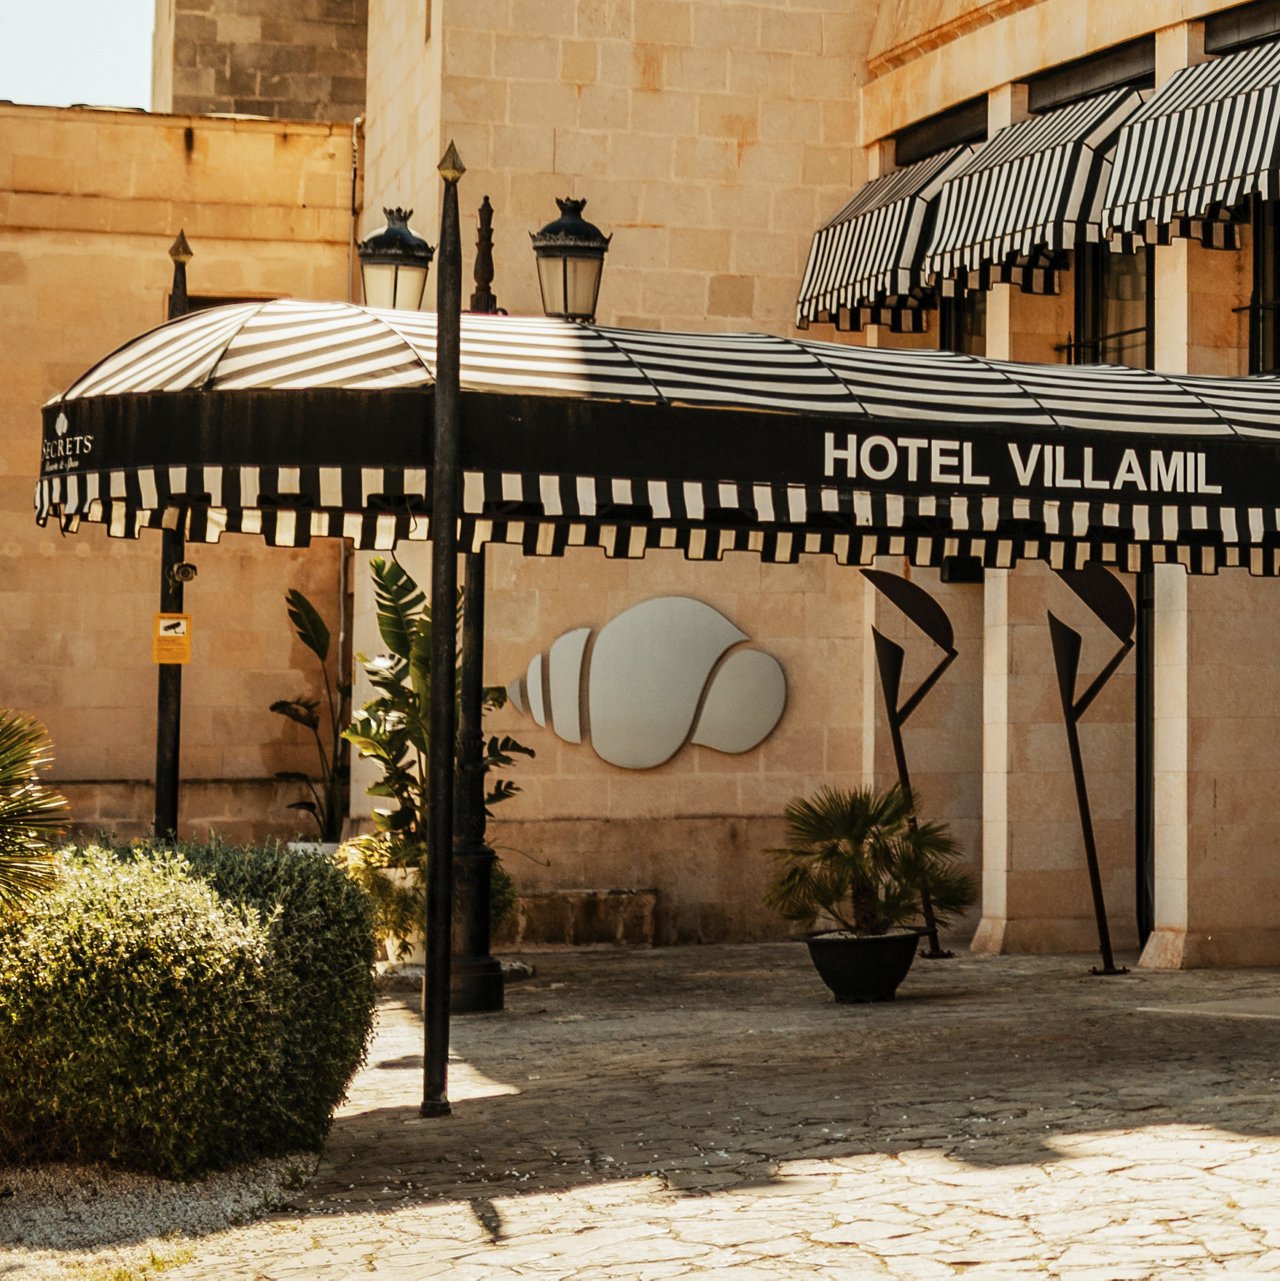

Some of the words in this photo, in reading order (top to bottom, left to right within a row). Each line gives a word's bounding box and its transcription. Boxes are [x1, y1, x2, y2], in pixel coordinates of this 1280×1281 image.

[42, 435, 94, 461] SECRETS
[824, 432, 990, 485] HOTEL
[1008, 443, 1222, 494] VILLAMIL
